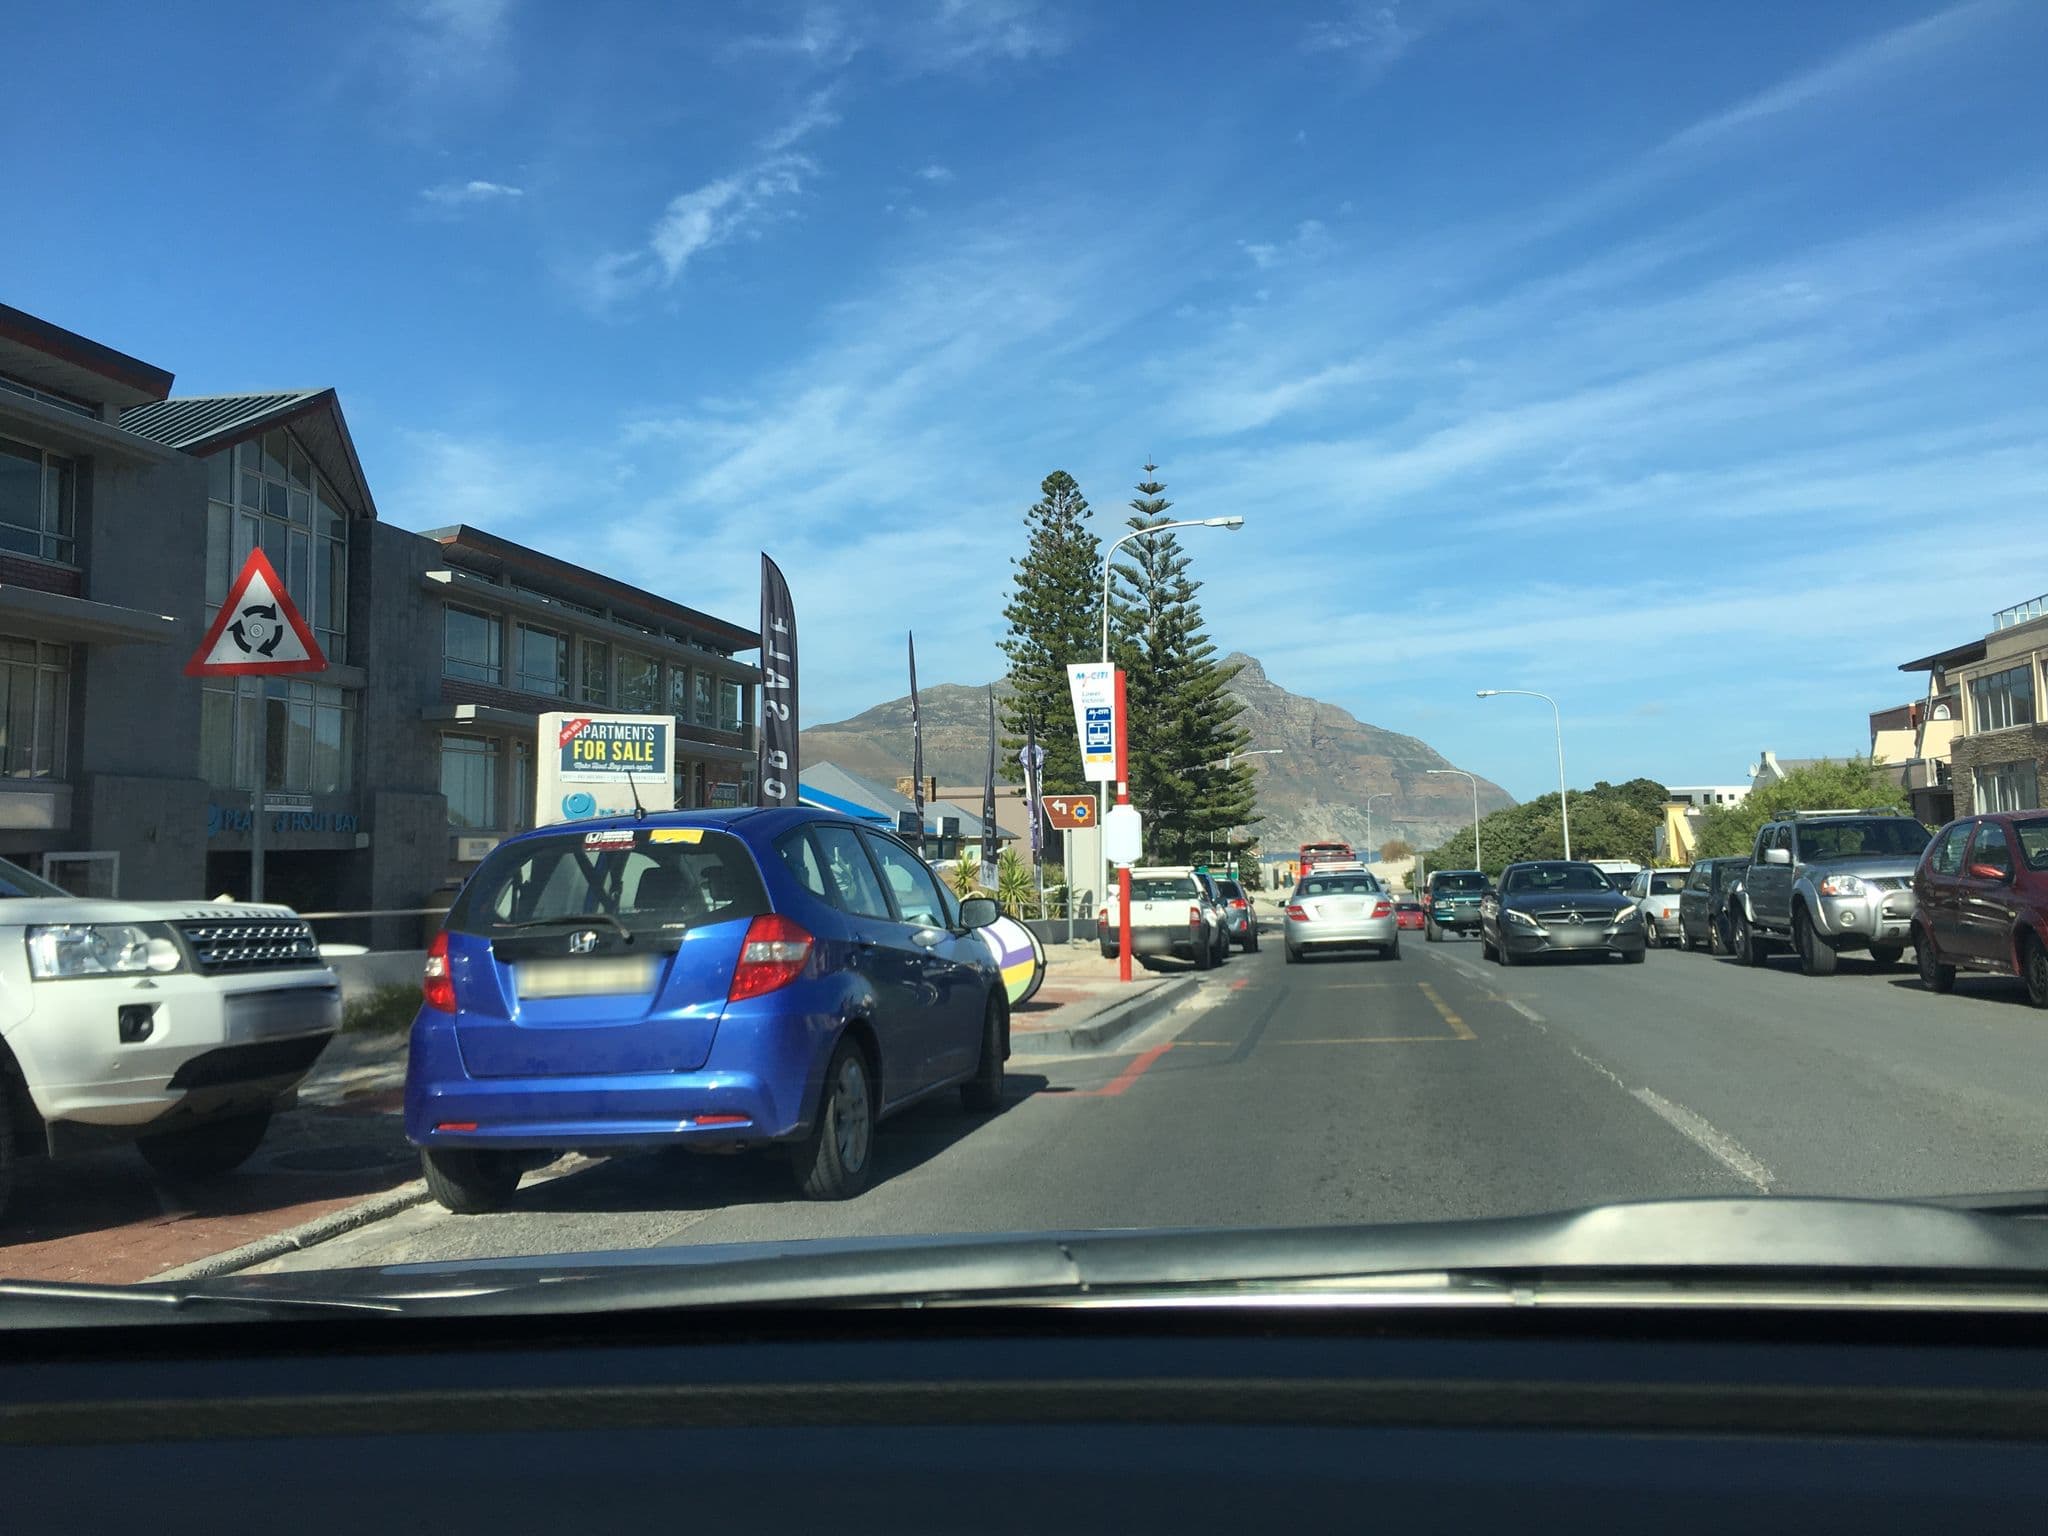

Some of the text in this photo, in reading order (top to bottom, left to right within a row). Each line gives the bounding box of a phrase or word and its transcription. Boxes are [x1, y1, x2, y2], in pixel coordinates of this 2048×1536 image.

[575, 725, 655, 741] APARTMENTS
[573, 740, 655, 762] FOR SALE
